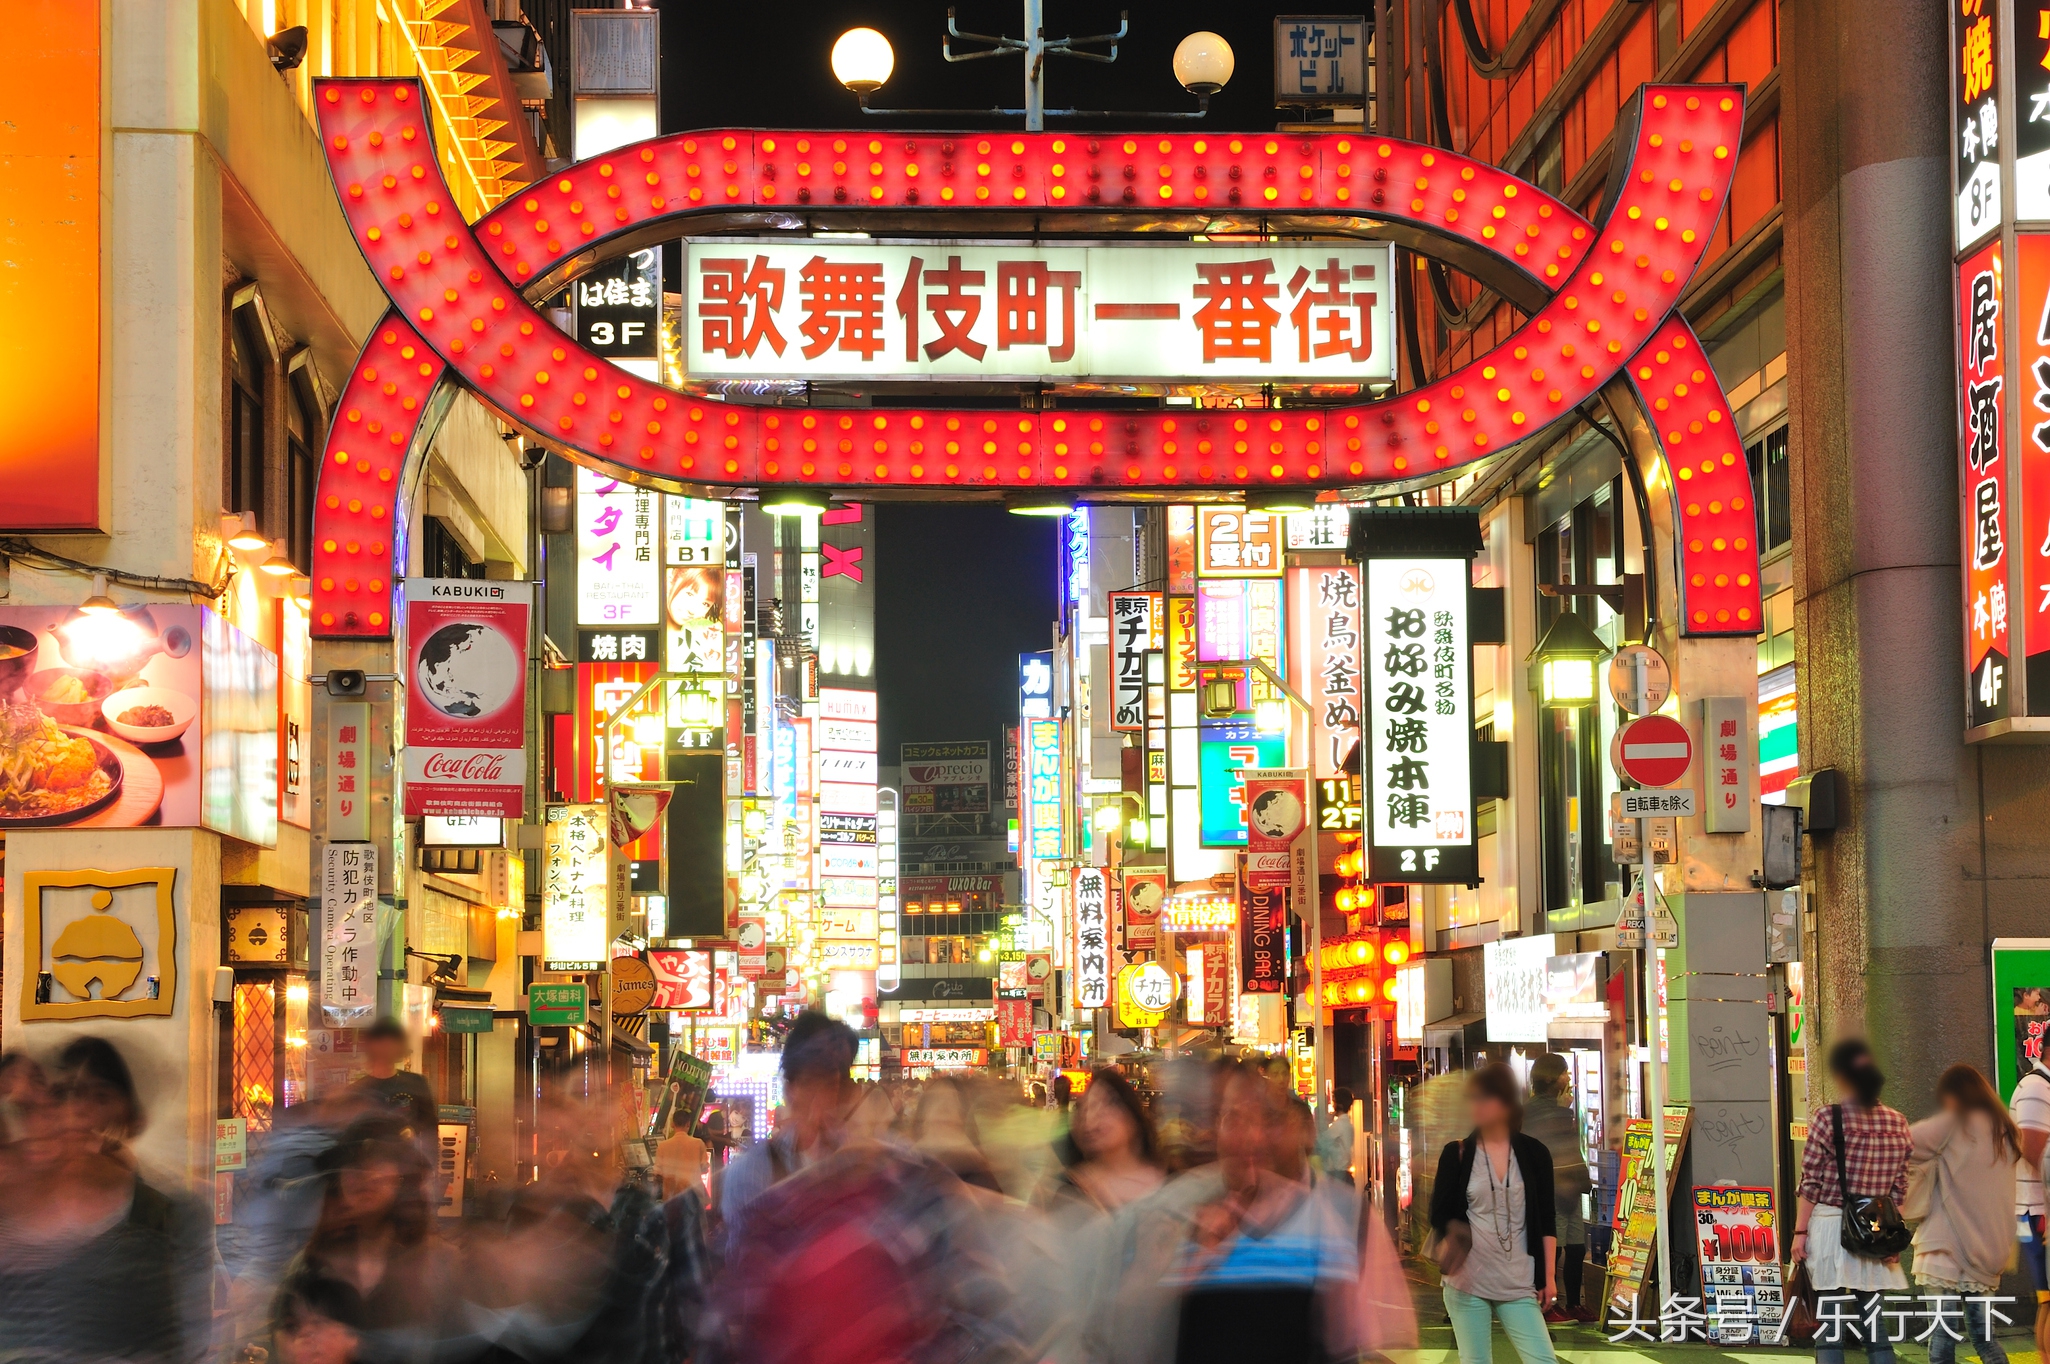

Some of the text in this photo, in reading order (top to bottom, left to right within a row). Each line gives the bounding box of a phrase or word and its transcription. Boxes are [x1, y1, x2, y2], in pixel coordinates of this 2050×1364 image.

[1290, 25, 1354, 58] ポケット
[1300, 60, 1344, 93] ビル
[1963, 97, 1998, 163] 本陣
[1971, 177, 1993, 226] 8F
[698, 255, 1378, 363] 歌舞伎町一番街
[590, 321, 646, 345] 3F
[1969, 271, 2003, 570] 居酒屋
[1210, 513, 1270, 542] 2F
[679, 547, 709, 562] B1
[1210, 542, 1271, 567] 受付
[603, 604, 632, 620] 3F
[1114, 597, 1149, 617] 東京
[1973, 579, 2006, 641] 本陣
[592, 634, 646, 661] 焼肉
[1433, 610, 1456, 716] 歌舞伎町名物
[1978, 657, 2003, 708] 4F
[1384, 606, 1432, 829] お好み焼本陣
[677, 728, 714, 748] 4F
[905, 745, 986, 757] コミック&ネットカフェ
[338, 725, 357, 817] 劇場通り
[423, 752, 508, 780] Coca-Cola
[1719, 719, 1738, 809] 劇場通り
[422, 808, 505, 816] www.kabukicho.or.jp
[549, 807, 568, 822] 5F
[1626, 796, 1690, 812] 自転車を除く
[327, 849, 338, 895] Security
[1400, 848, 1440, 872] 2F
[363, 849, 375, 925] 歌舞伎町地区
[947, 876, 976, 892] LUXOR
[977, 876, 993, 892] Bar
[341, 849, 360, 1002] 防犯カメラ作動中
[1079, 874, 1105, 1000] 無料案内所
[1253, 896, 1272, 978] DINING BAR
[1204, 944, 1227, 955] 東京
[1206, 955, 1225, 1009] チカラ
[534, 988, 582, 1004] 大塚歯科
[566, 1012, 580, 1022] 4F
[1136, 1017, 1149, 1026] B1
[1205, 1011, 1227, 1025] めし
[909, 1049, 973, 1063] 無料案内所
[1696, 1191, 1770, 1207] まんが喫茶
[1702, 1224, 1776, 1263] ¥100
[1715, 1267, 1740, 1275] 身分証
[1719, 1275, 1736, 1283] 不要
[1760, 1275, 1776, 1284] 無料
[1757, 1290, 1781, 1302] 分煙
